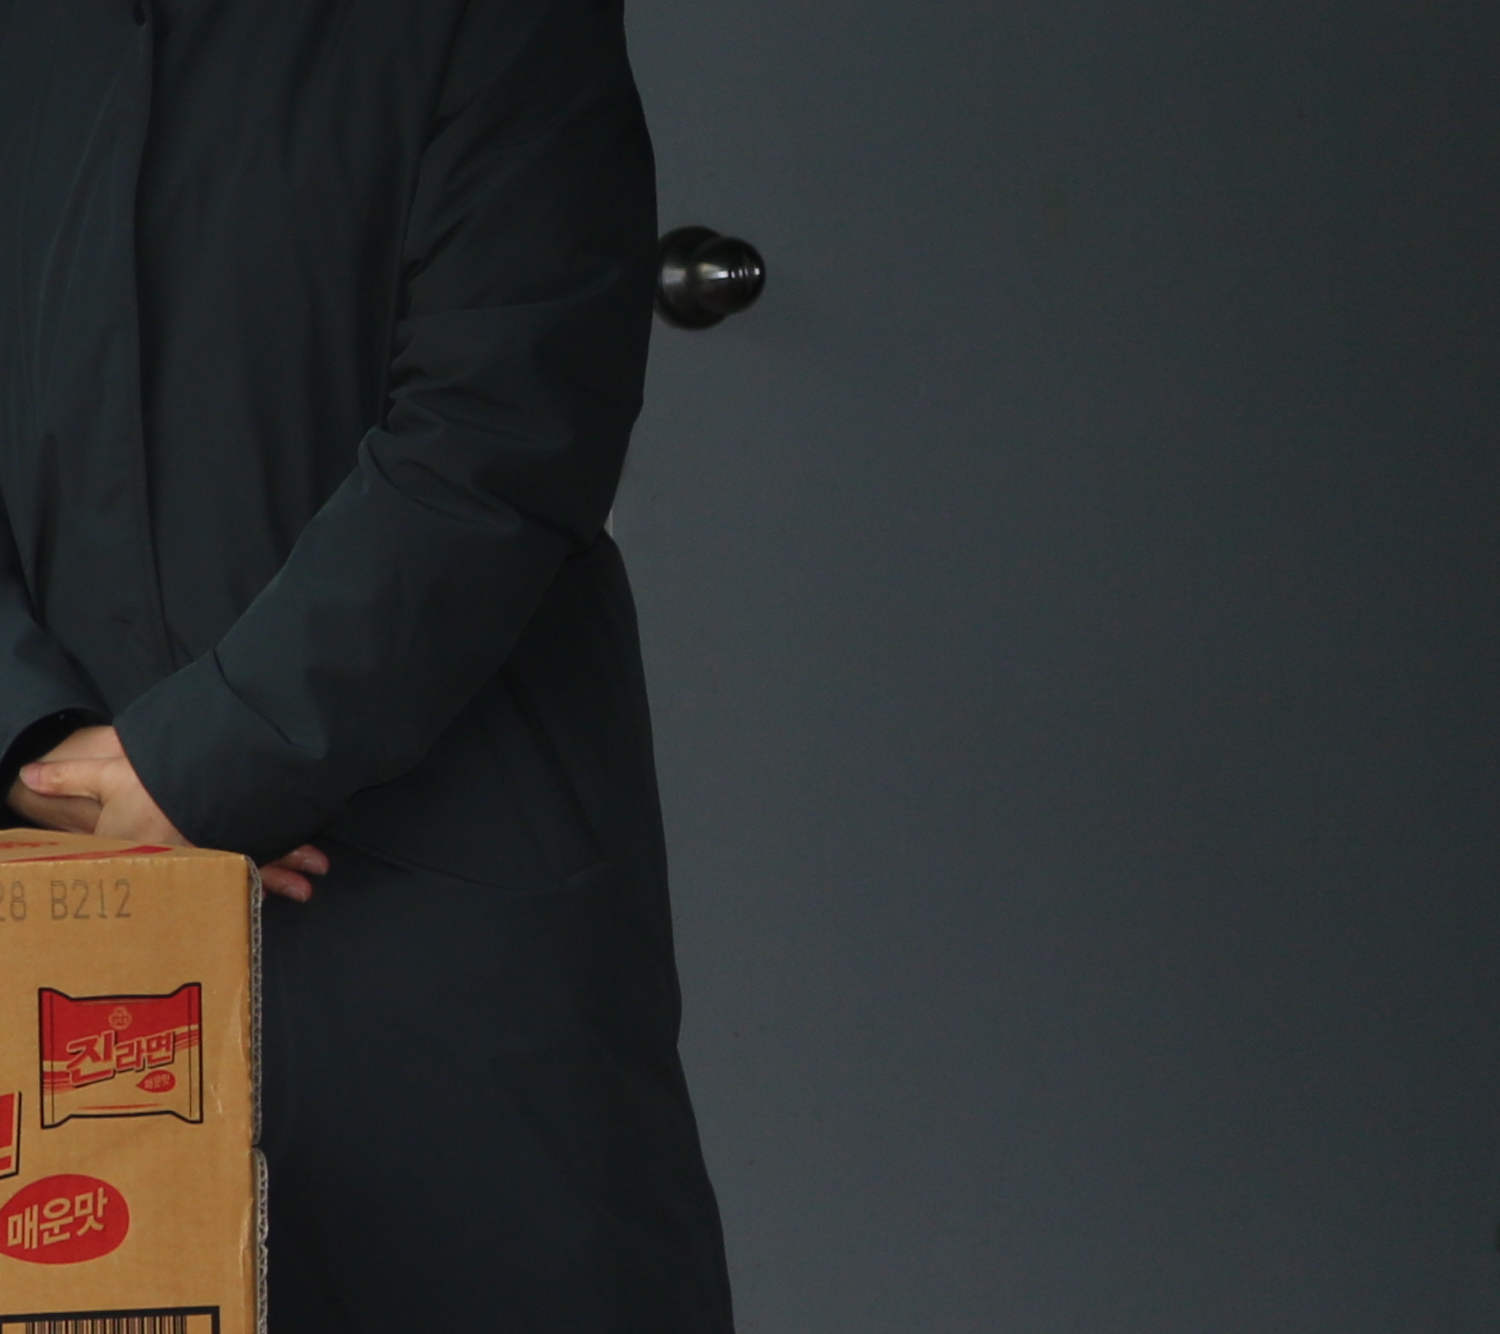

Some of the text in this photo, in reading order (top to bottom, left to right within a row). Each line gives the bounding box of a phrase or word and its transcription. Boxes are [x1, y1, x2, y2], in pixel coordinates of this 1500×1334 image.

[50, 879, 132, 921] B212
[64, 1027, 177, 1090] 진라면
[4, 1188, 107, 1248] 매운맛
